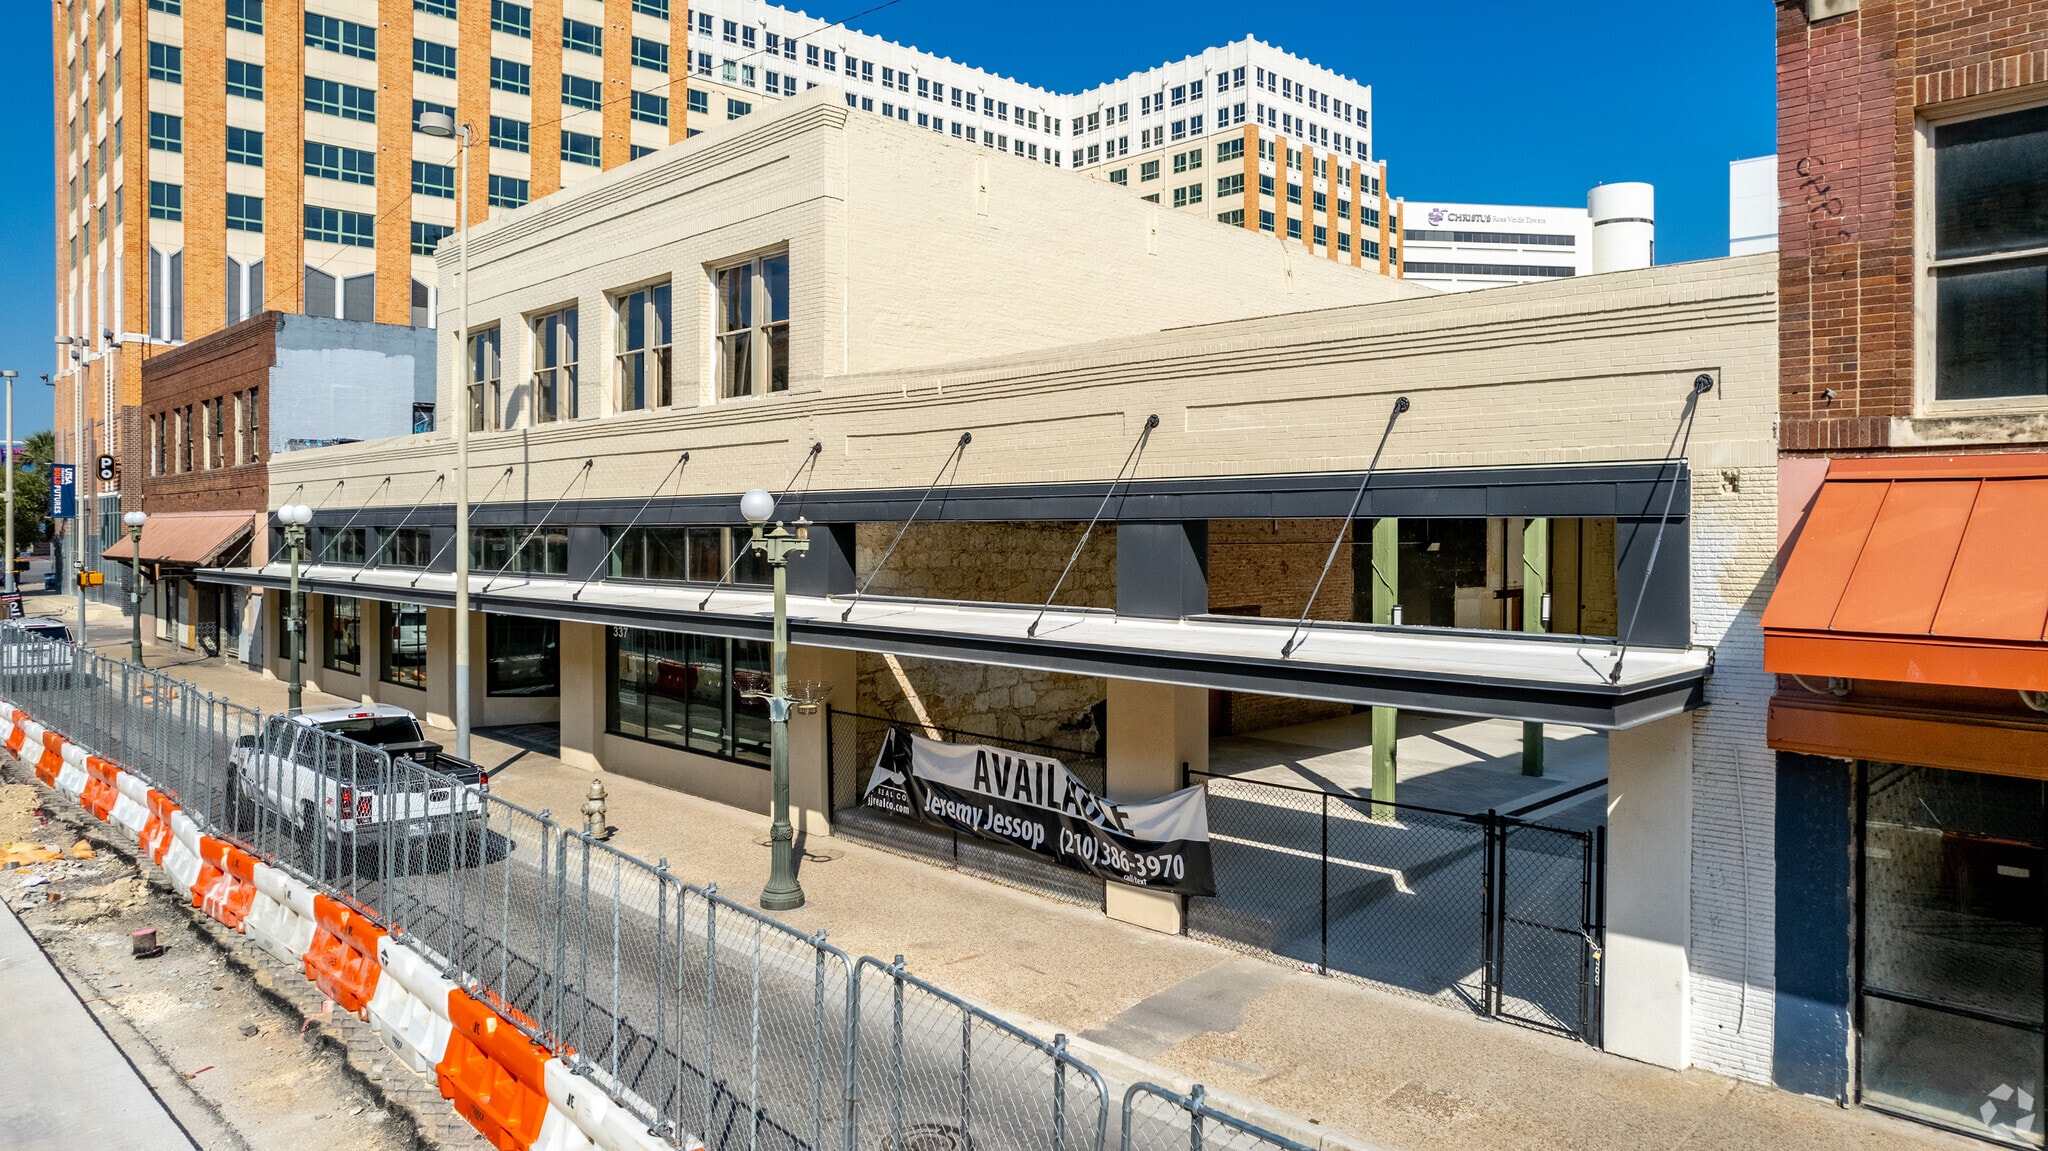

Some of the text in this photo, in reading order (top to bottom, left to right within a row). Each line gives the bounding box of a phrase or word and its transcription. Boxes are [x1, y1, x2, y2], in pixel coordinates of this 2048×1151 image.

[1447, 212, 1491, 223] CHRISTUS
[65, 467, 73, 485] UTSA
[53, 485, 62, 514] FUTURES
[613, 626, 628, 638] 337
[924, 788, 1045, 850] Jeremy Jessop
[1059, 827, 1185, 880] (210) 386-3970
